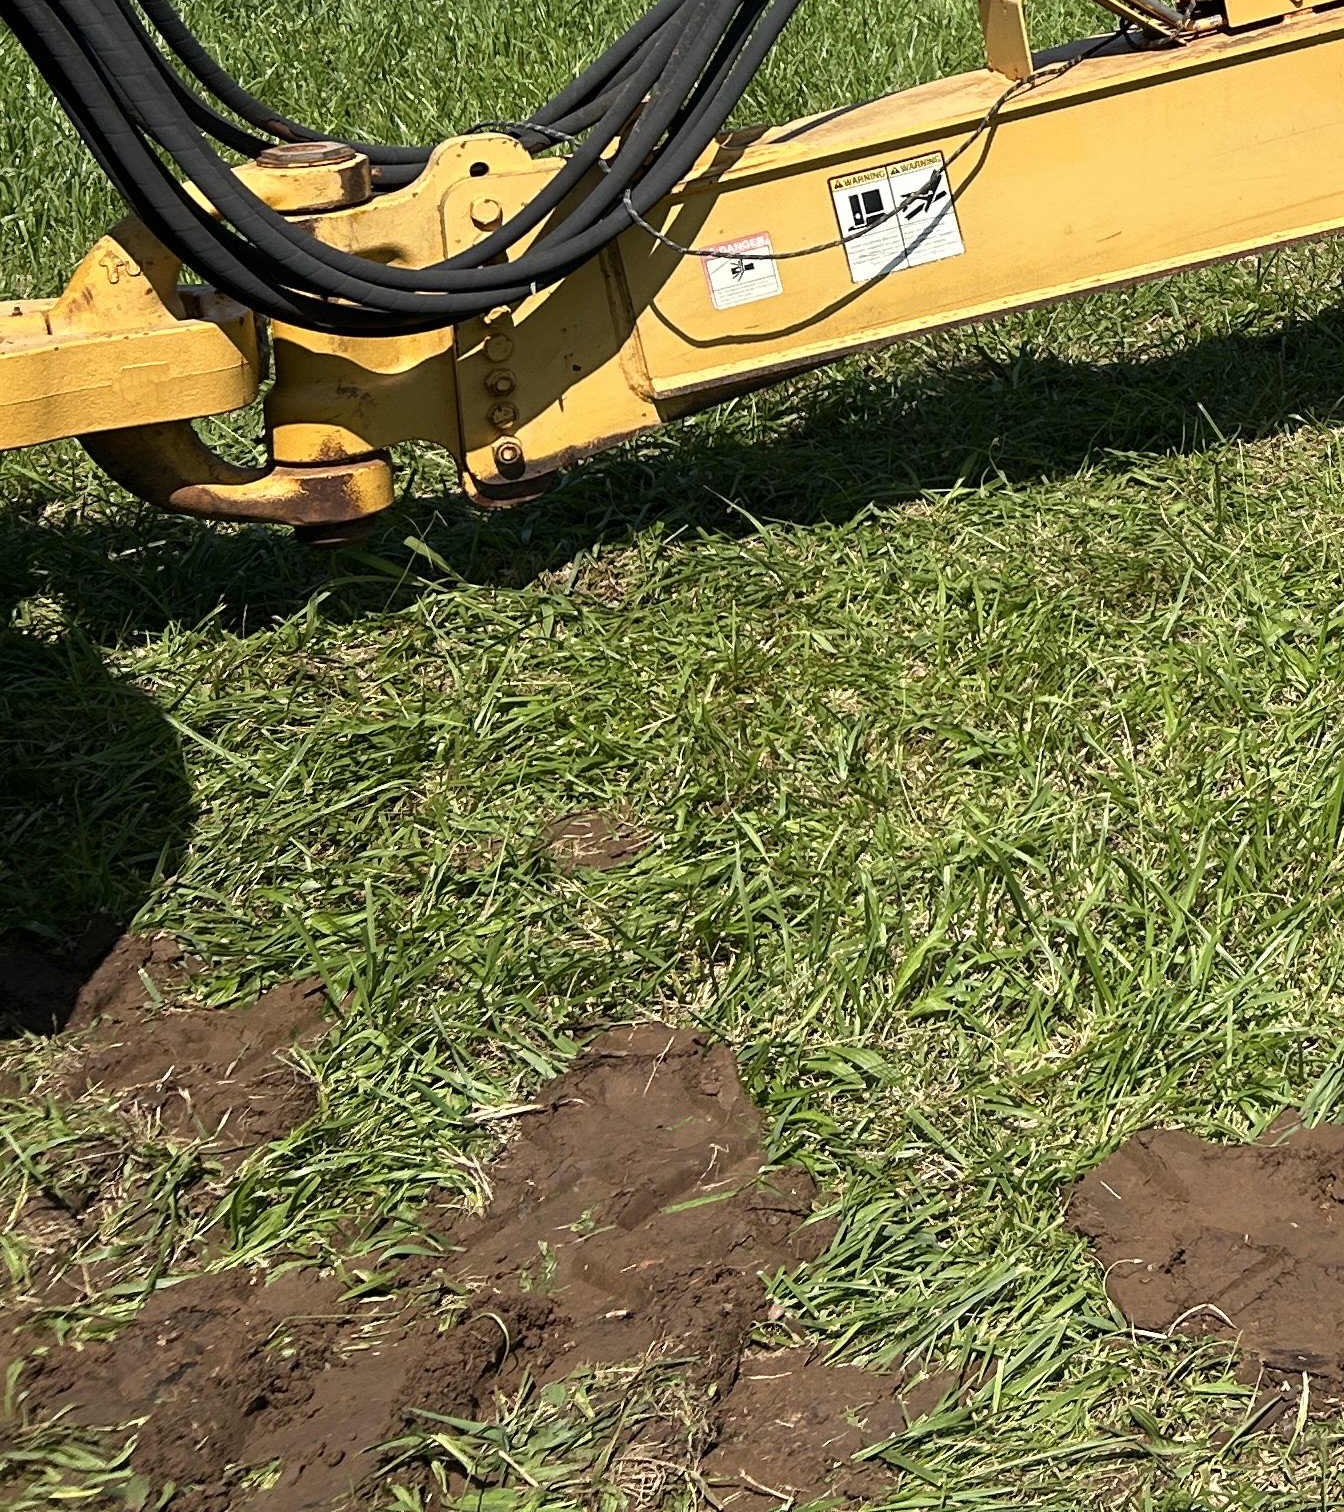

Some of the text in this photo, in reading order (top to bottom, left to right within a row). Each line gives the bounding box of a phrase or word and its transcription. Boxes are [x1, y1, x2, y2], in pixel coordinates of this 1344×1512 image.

[900, 154, 942, 173] WARNING
[843, 170, 886, 187] WARNING
[718, 236, 765, 255] DANGER
